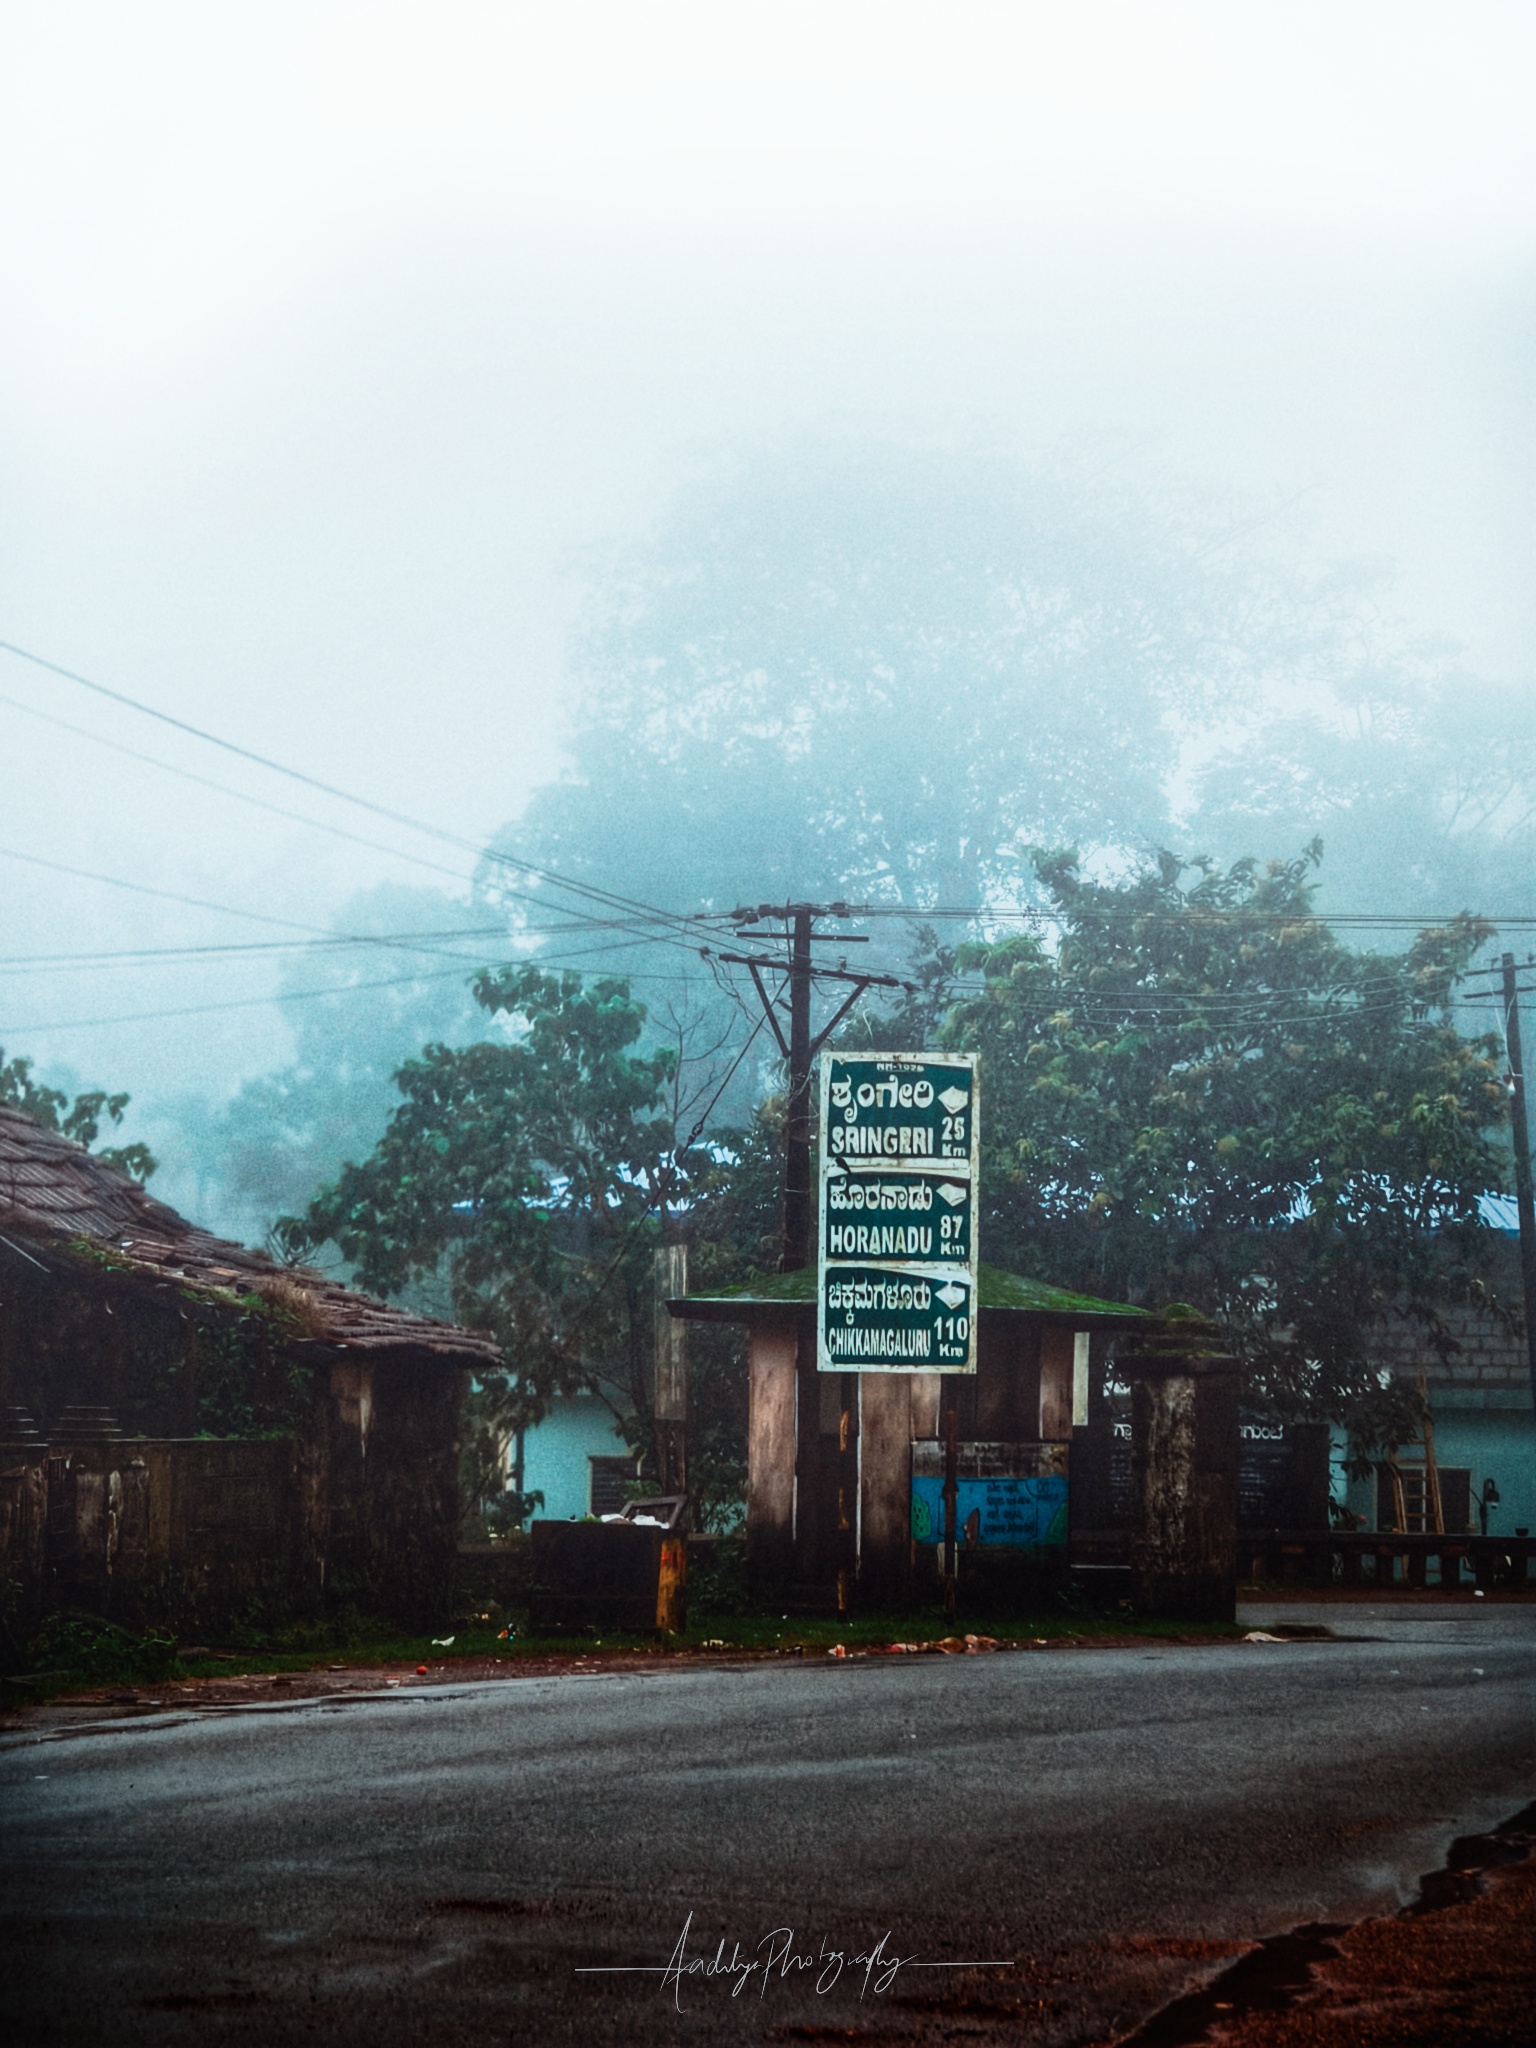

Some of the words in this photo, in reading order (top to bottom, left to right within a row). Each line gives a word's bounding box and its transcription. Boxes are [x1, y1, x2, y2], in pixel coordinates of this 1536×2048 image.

[831, 1074, 934, 1123] ಶೃಂಗೇರಿ
[831, 1126, 934, 1154] SRINGERI
[830, 1177, 932, 1210] ಹೊರನಾಡು
[830, 1225, 932, 1254] HORANADU
[940, 1215, 963, 1239] 87
[829, 1277, 931, 1325] ಚಿಕ್ಕಮಗಳೂರು
[828, 1328, 931, 1357] CHIKKAMAGALURU
[934, 1316, 968, 1340] 110
